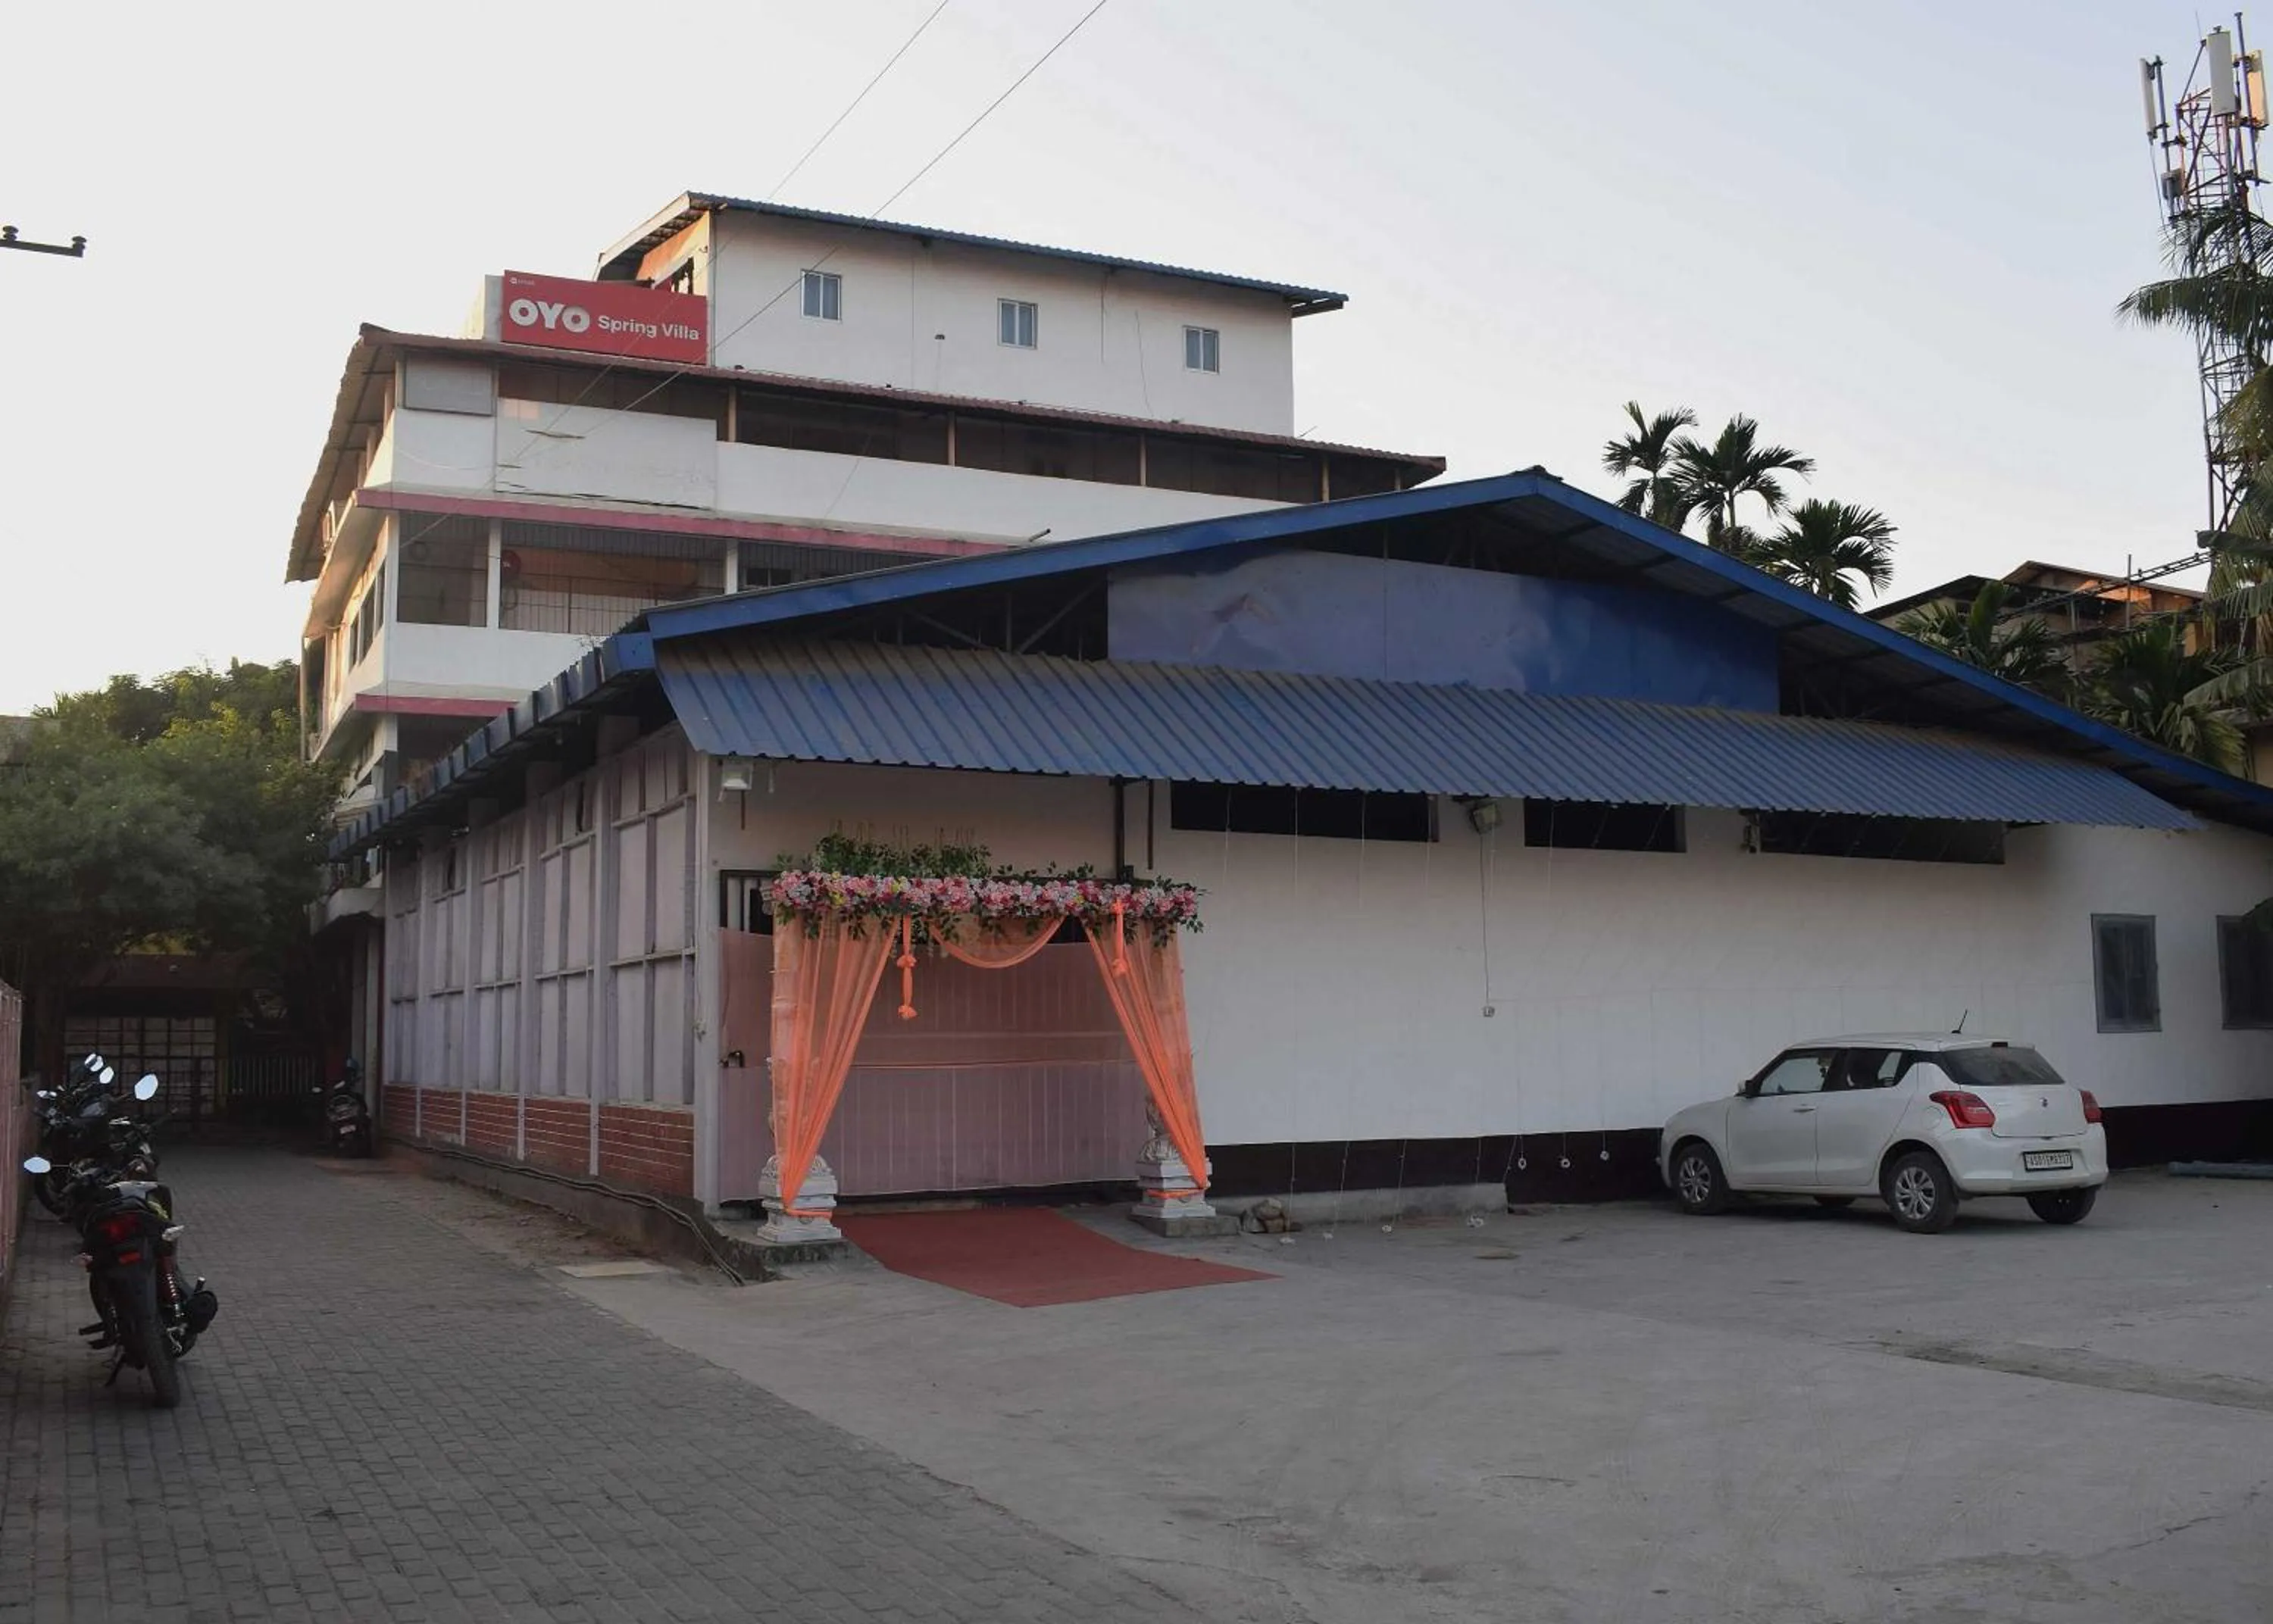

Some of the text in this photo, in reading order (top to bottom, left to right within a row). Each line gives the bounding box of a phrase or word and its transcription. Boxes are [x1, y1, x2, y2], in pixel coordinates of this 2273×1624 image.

[509, 298, 699, 340] OYO Spring Villa
